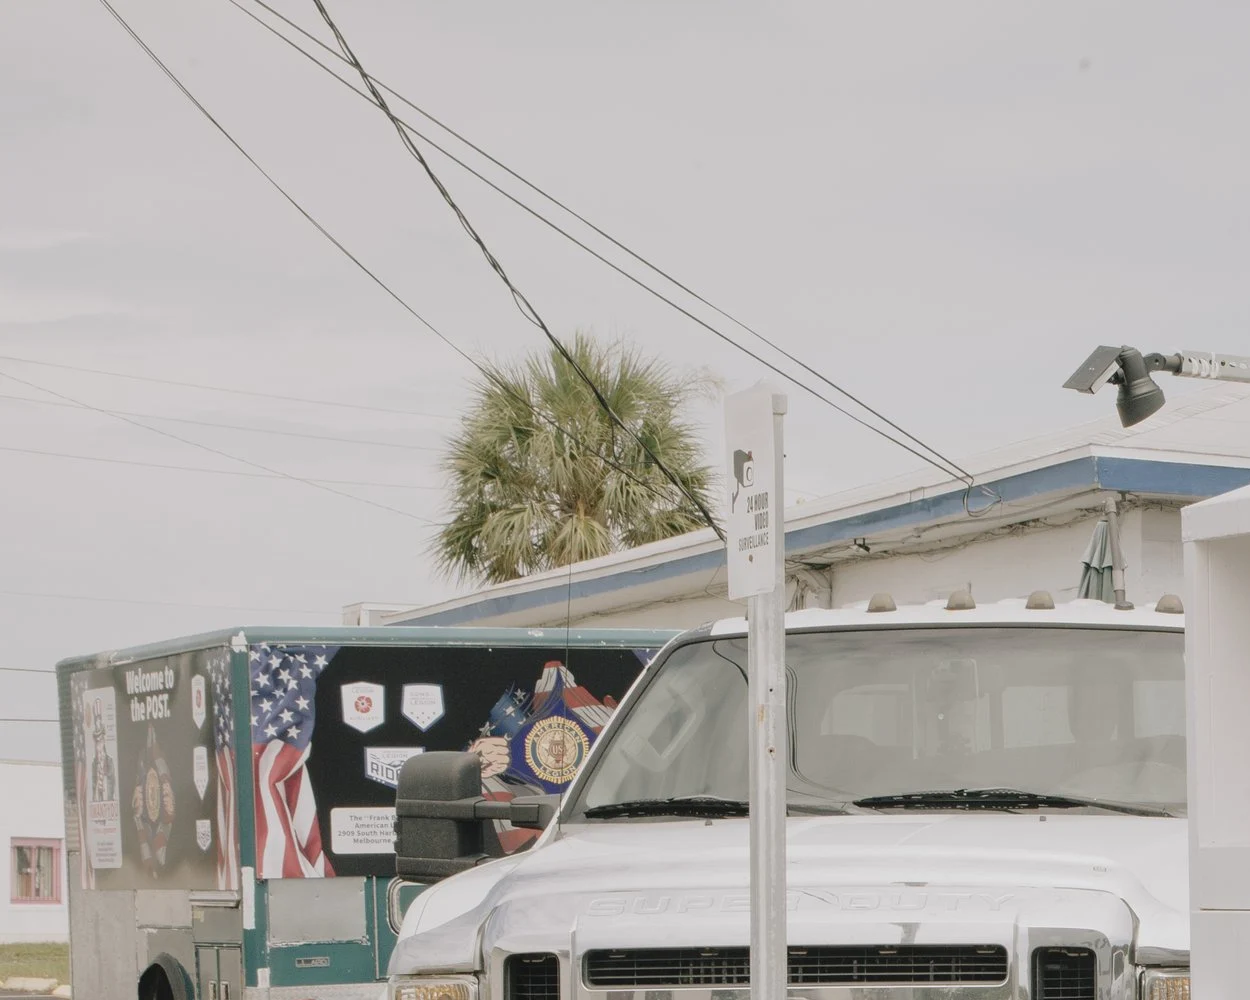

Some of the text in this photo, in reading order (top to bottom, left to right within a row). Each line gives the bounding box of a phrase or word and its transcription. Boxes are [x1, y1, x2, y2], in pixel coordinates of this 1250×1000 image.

[746, 492, 768, 513] 24 HOUR
[754, 511, 769, 531] VIDEO
[738, 532, 769, 552] SURVEILLANCE
[126, 668, 162, 694] Welcome
[163, 666, 175, 689] to
[130, 697, 146, 722] the
[146, 693, 171, 720] POST.
[841, 893, 1015, 911] DUTY
